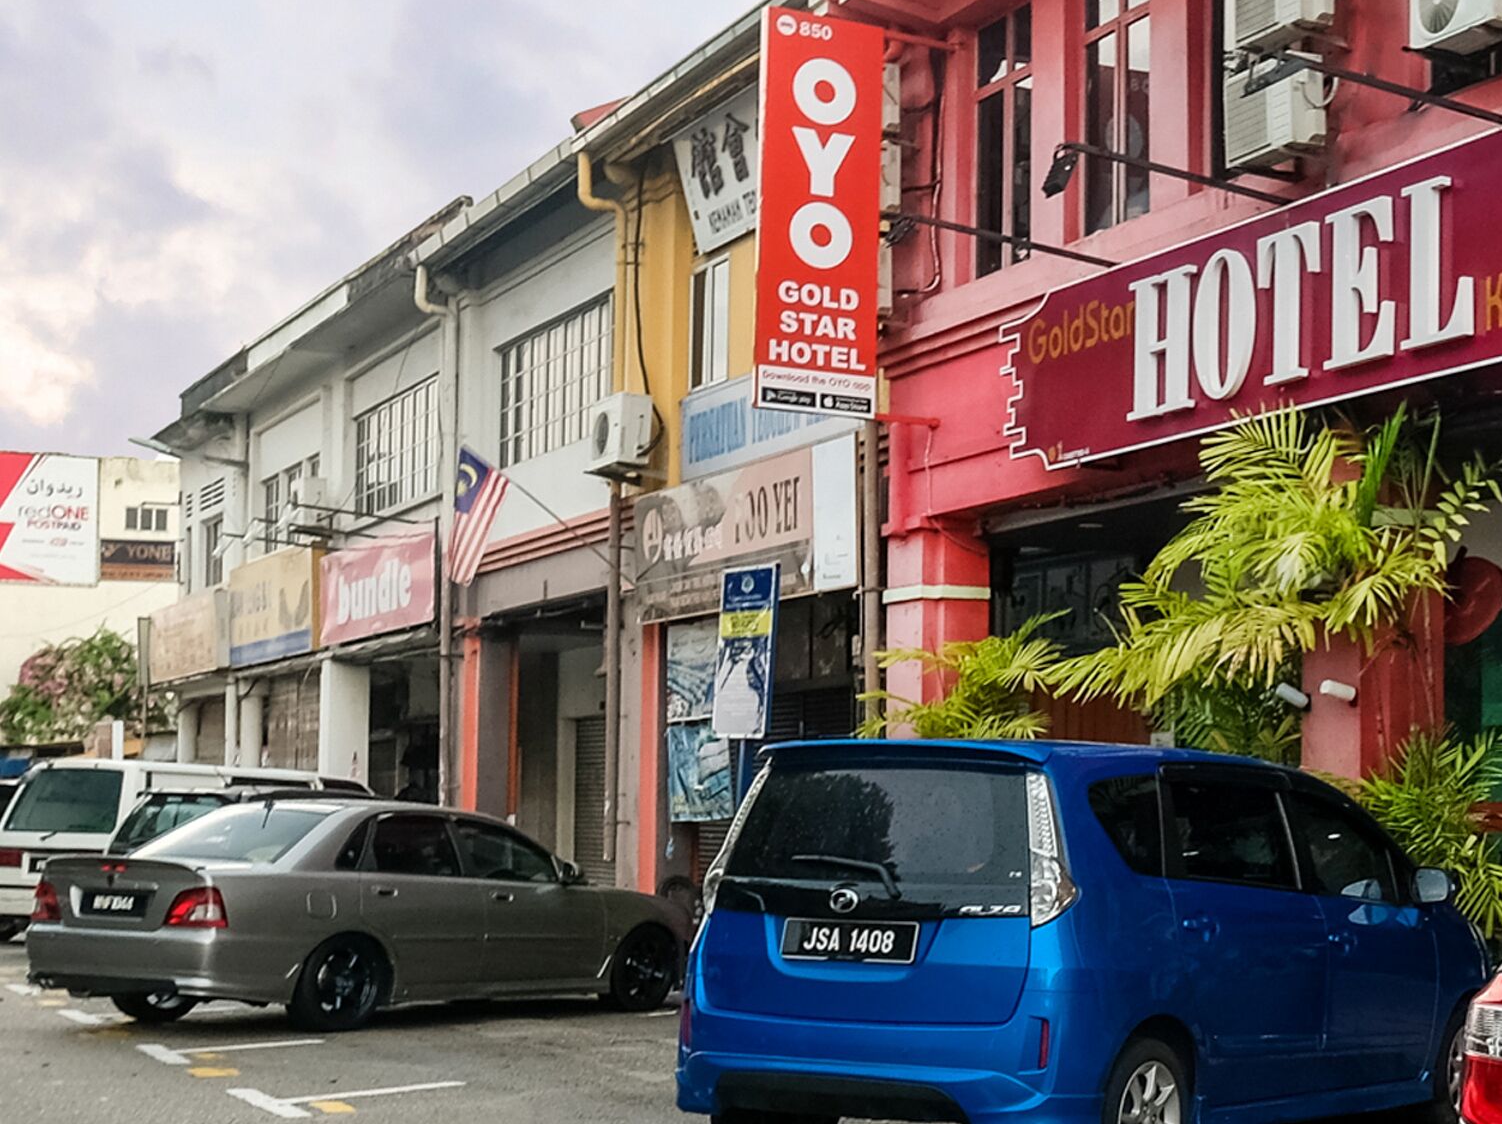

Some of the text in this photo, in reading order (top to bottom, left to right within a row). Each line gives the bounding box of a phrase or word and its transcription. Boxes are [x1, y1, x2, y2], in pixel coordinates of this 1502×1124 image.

[799, 21, 833, 41] 850
[788, 57, 857, 270] OYO
[777, 280, 860, 312] GOLD
[1027, 298, 1136, 364] GoldStar
[1126, 174, 1475, 422] HOTEL
[779, 310, 857, 342] STAR
[768, 338, 867, 372] HOTEL
[337, 557, 412, 625] bundle
[803, 926, 896, 955] JSA 1408
